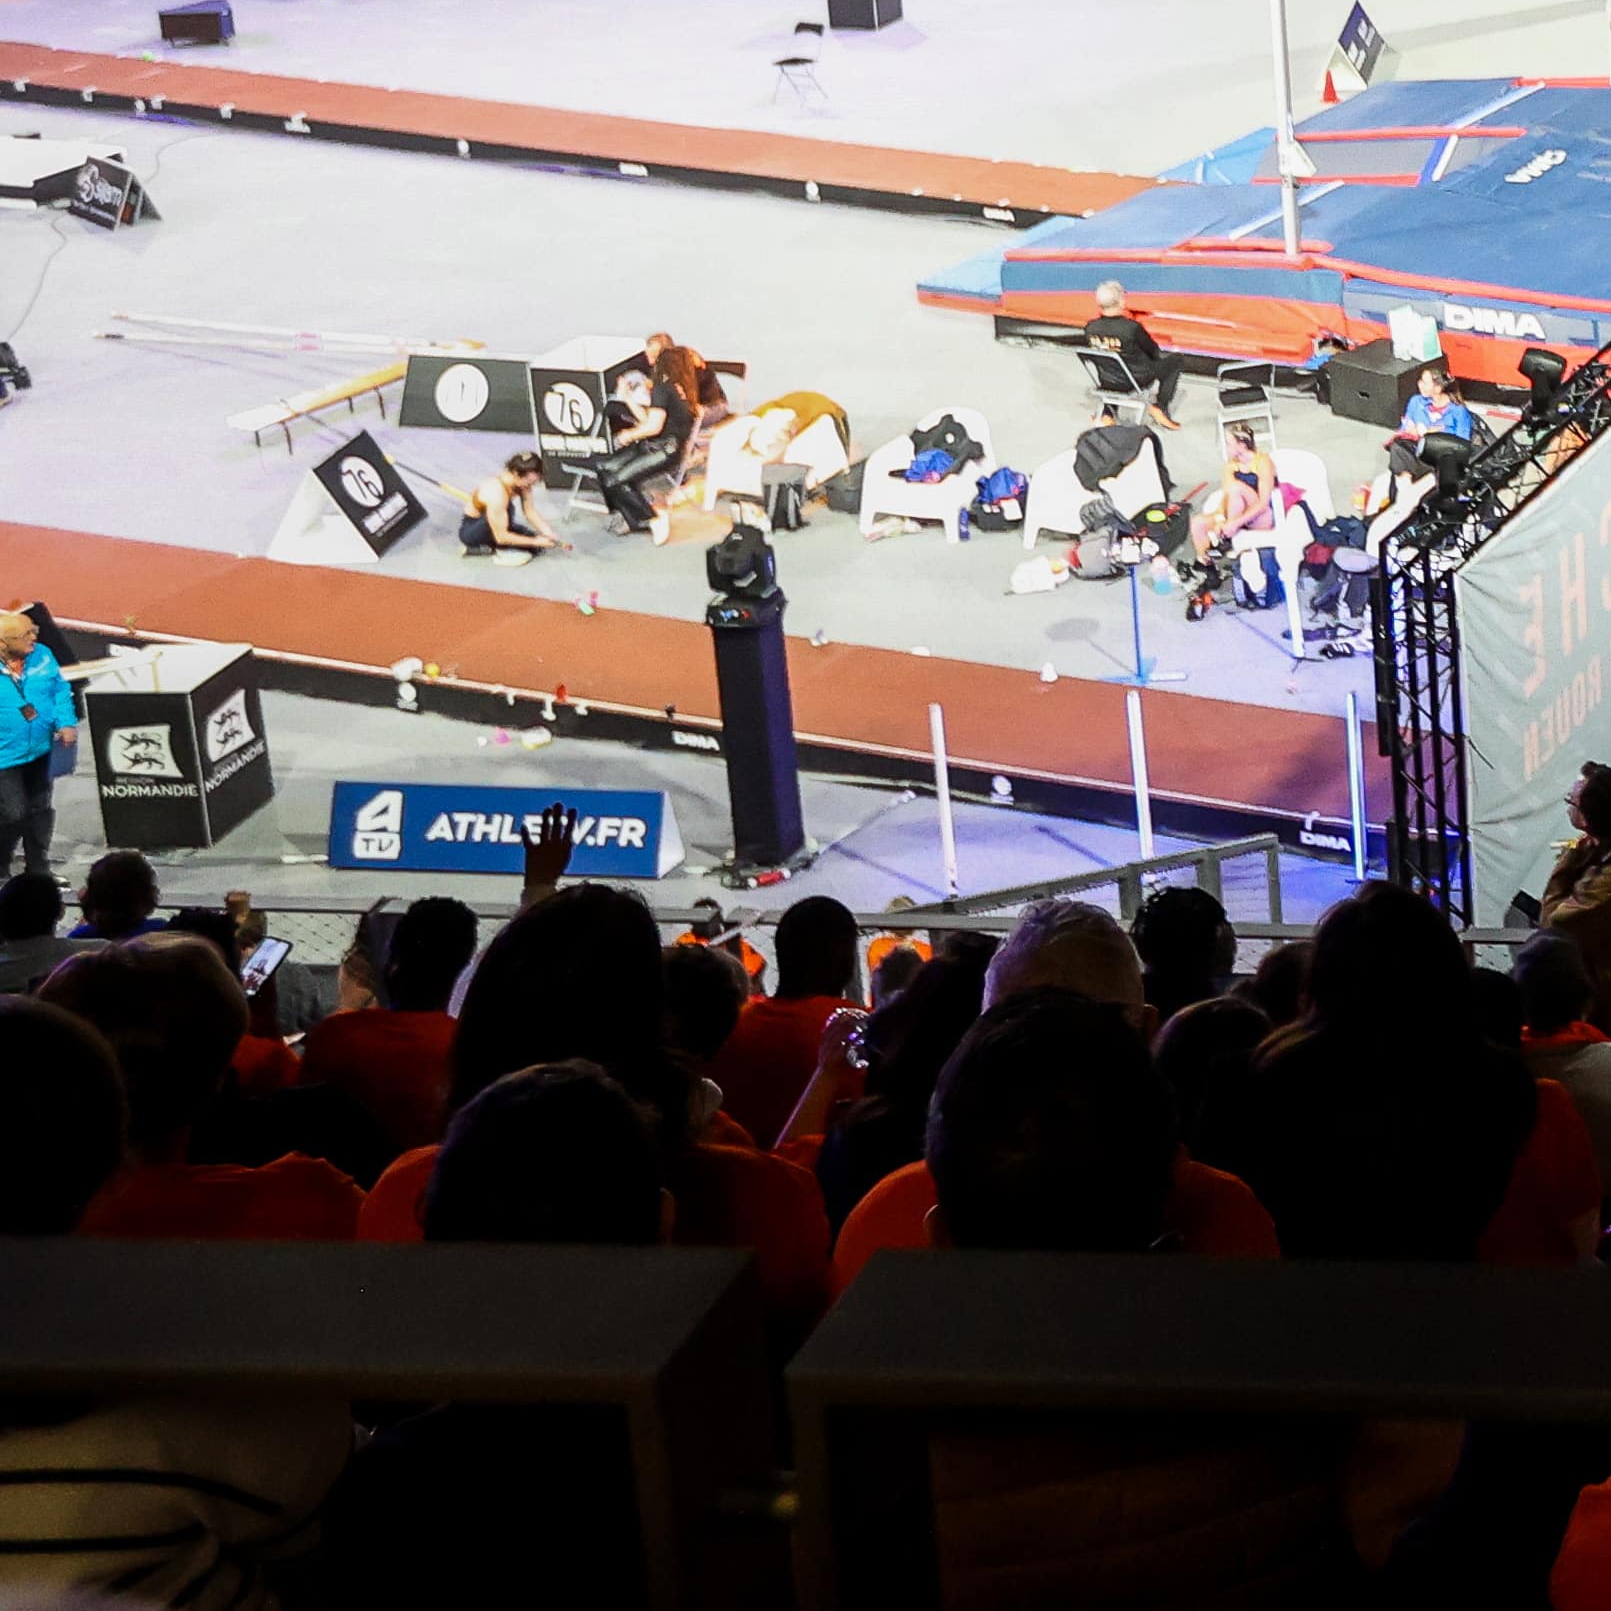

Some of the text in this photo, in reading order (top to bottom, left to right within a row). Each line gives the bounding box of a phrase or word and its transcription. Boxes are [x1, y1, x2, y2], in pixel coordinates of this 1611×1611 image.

[1443, 301, 1547, 340] DIMA
[205, 739, 266, 794] NORMANDIE
[102, 784, 200, 799] NORMANDIE
[1299, 830, 1352, 853] DIMA
